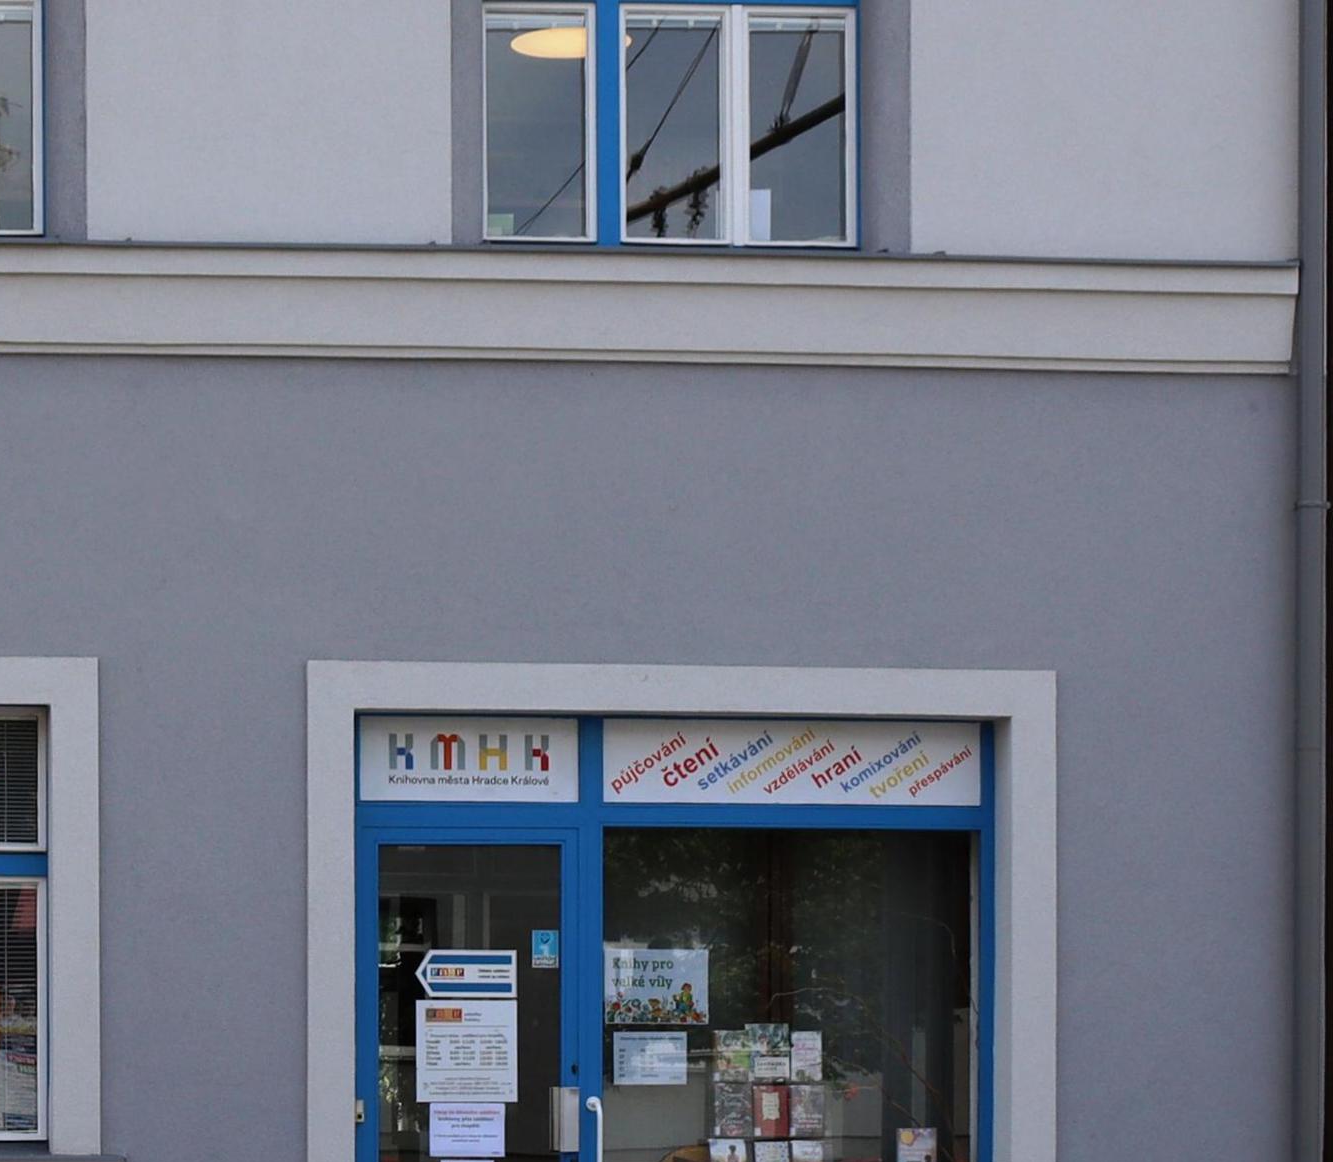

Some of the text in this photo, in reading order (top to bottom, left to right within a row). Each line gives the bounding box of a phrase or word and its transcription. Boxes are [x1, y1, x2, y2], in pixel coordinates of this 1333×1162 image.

[388, 775, 550, 786] Knihovna města Hradce Králové
[610, 731, 687, 794] půjčování
[661, 736, 720, 788] čtení
[697, 730, 774, 791] setkávání
[727, 726, 816, 793] informování
[763, 736, 835, 794] vzdělávání
[811, 745, 863, 789] hraní
[840, 730, 922, 793] komixování
[869, 751, 931, 799] tvoření
[908, 744, 973, 798] přespávání
[648, 976, 674, 989] víly
[652, 960, 674, 972] pro
